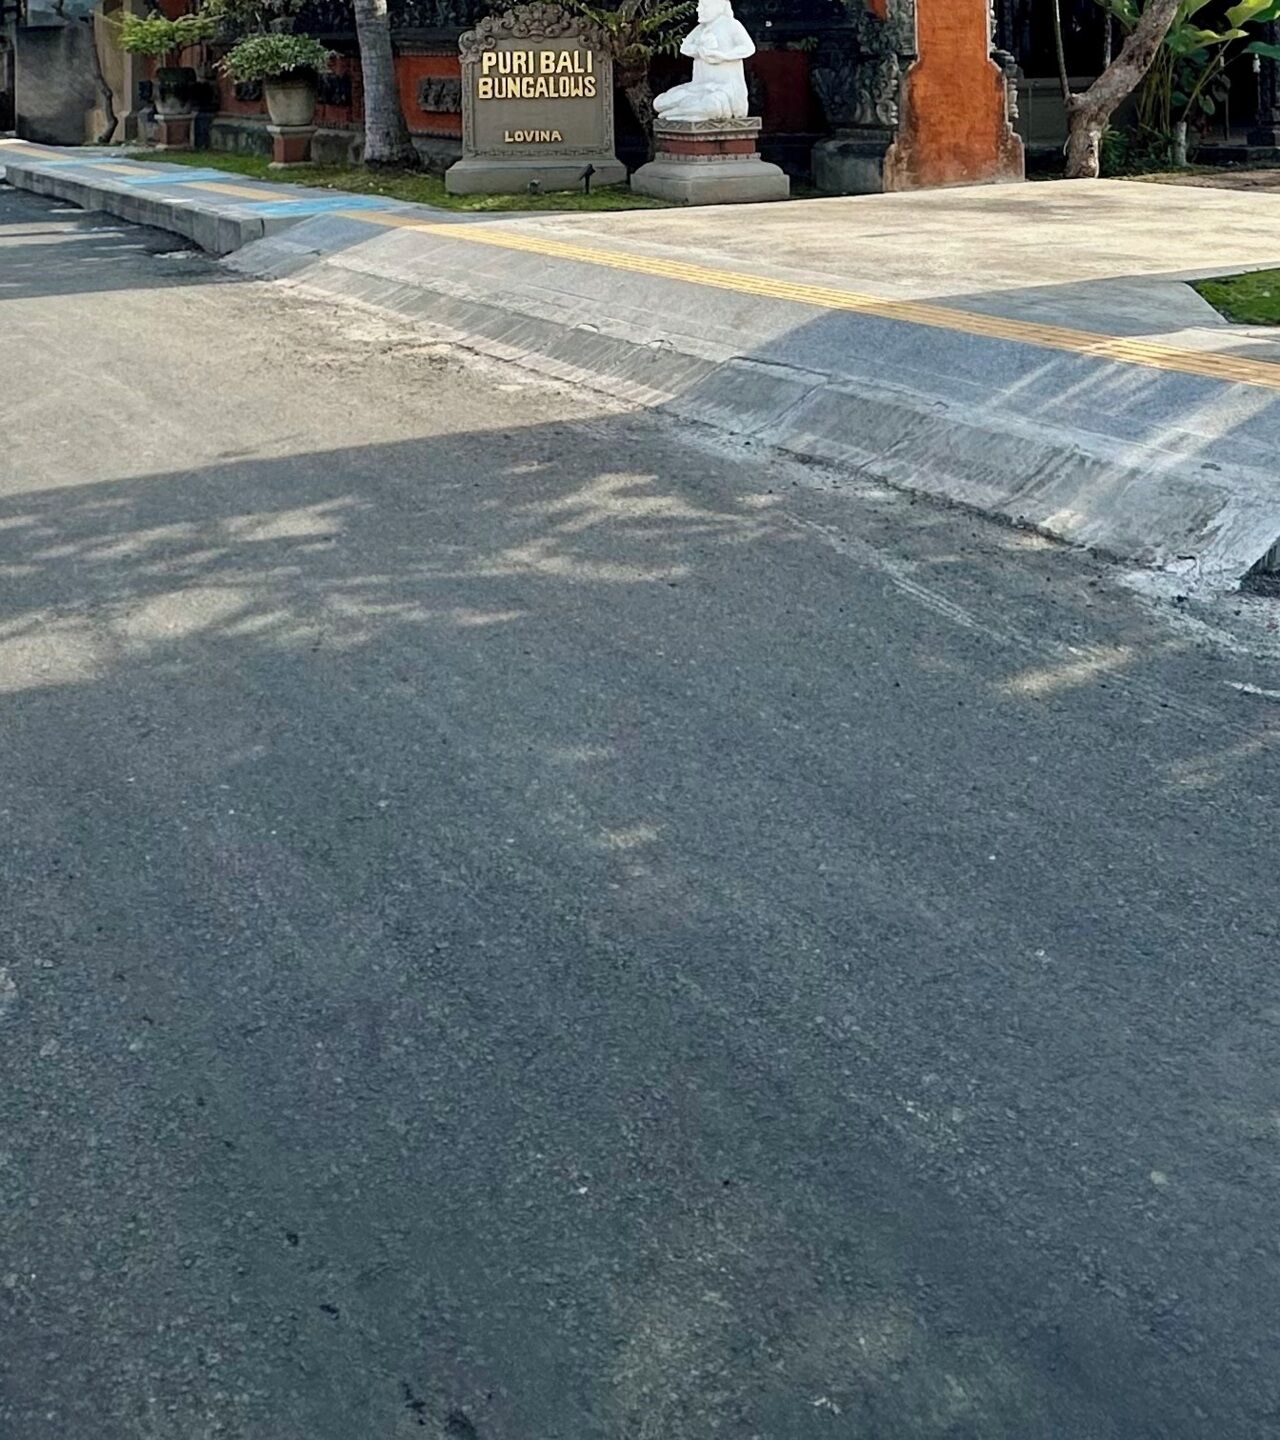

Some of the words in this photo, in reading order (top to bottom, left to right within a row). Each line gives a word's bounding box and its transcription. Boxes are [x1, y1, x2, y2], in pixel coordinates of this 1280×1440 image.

[482, 50, 534, 75] PURI
[540, 50, 593, 74] BALI
[478, 76, 596, 99] BUNGALOWS
[504, 130, 563, 143] LOVINA
